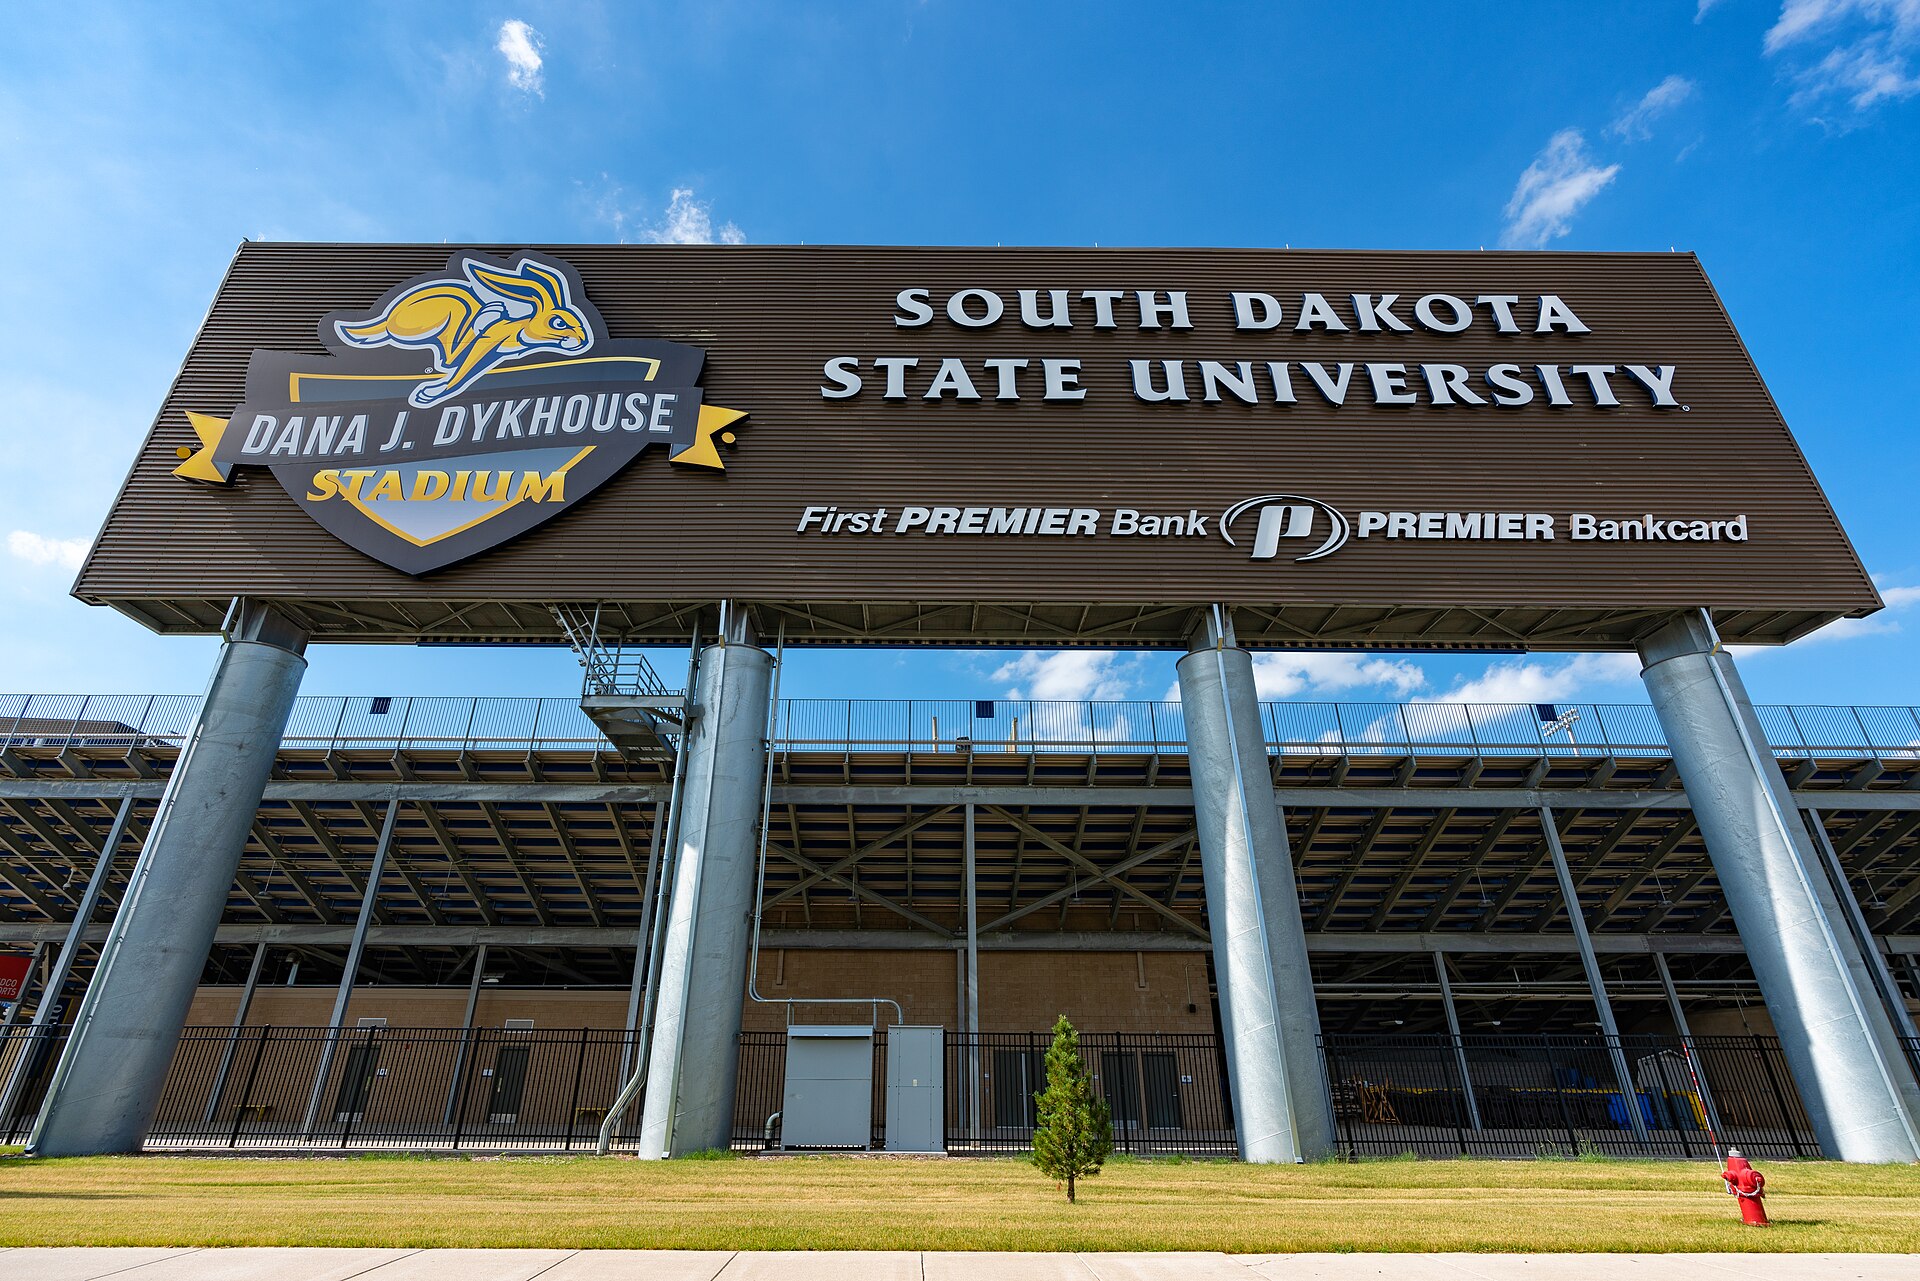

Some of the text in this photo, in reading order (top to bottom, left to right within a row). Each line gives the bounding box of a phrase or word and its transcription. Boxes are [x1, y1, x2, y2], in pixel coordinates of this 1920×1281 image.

[893, 288, 1592, 334] SOUTH DAKOTA
[820, 356, 1680, 409] STATE UNIVERSITY
[241, 392, 676, 457] DANA J. DYKHOUSE
[307, 468, 567, 503] STADIUM
[796, 506, 1210, 537] First PREMIER Bank
[1357, 511, 1748, 542] PREMIER Bankcard
